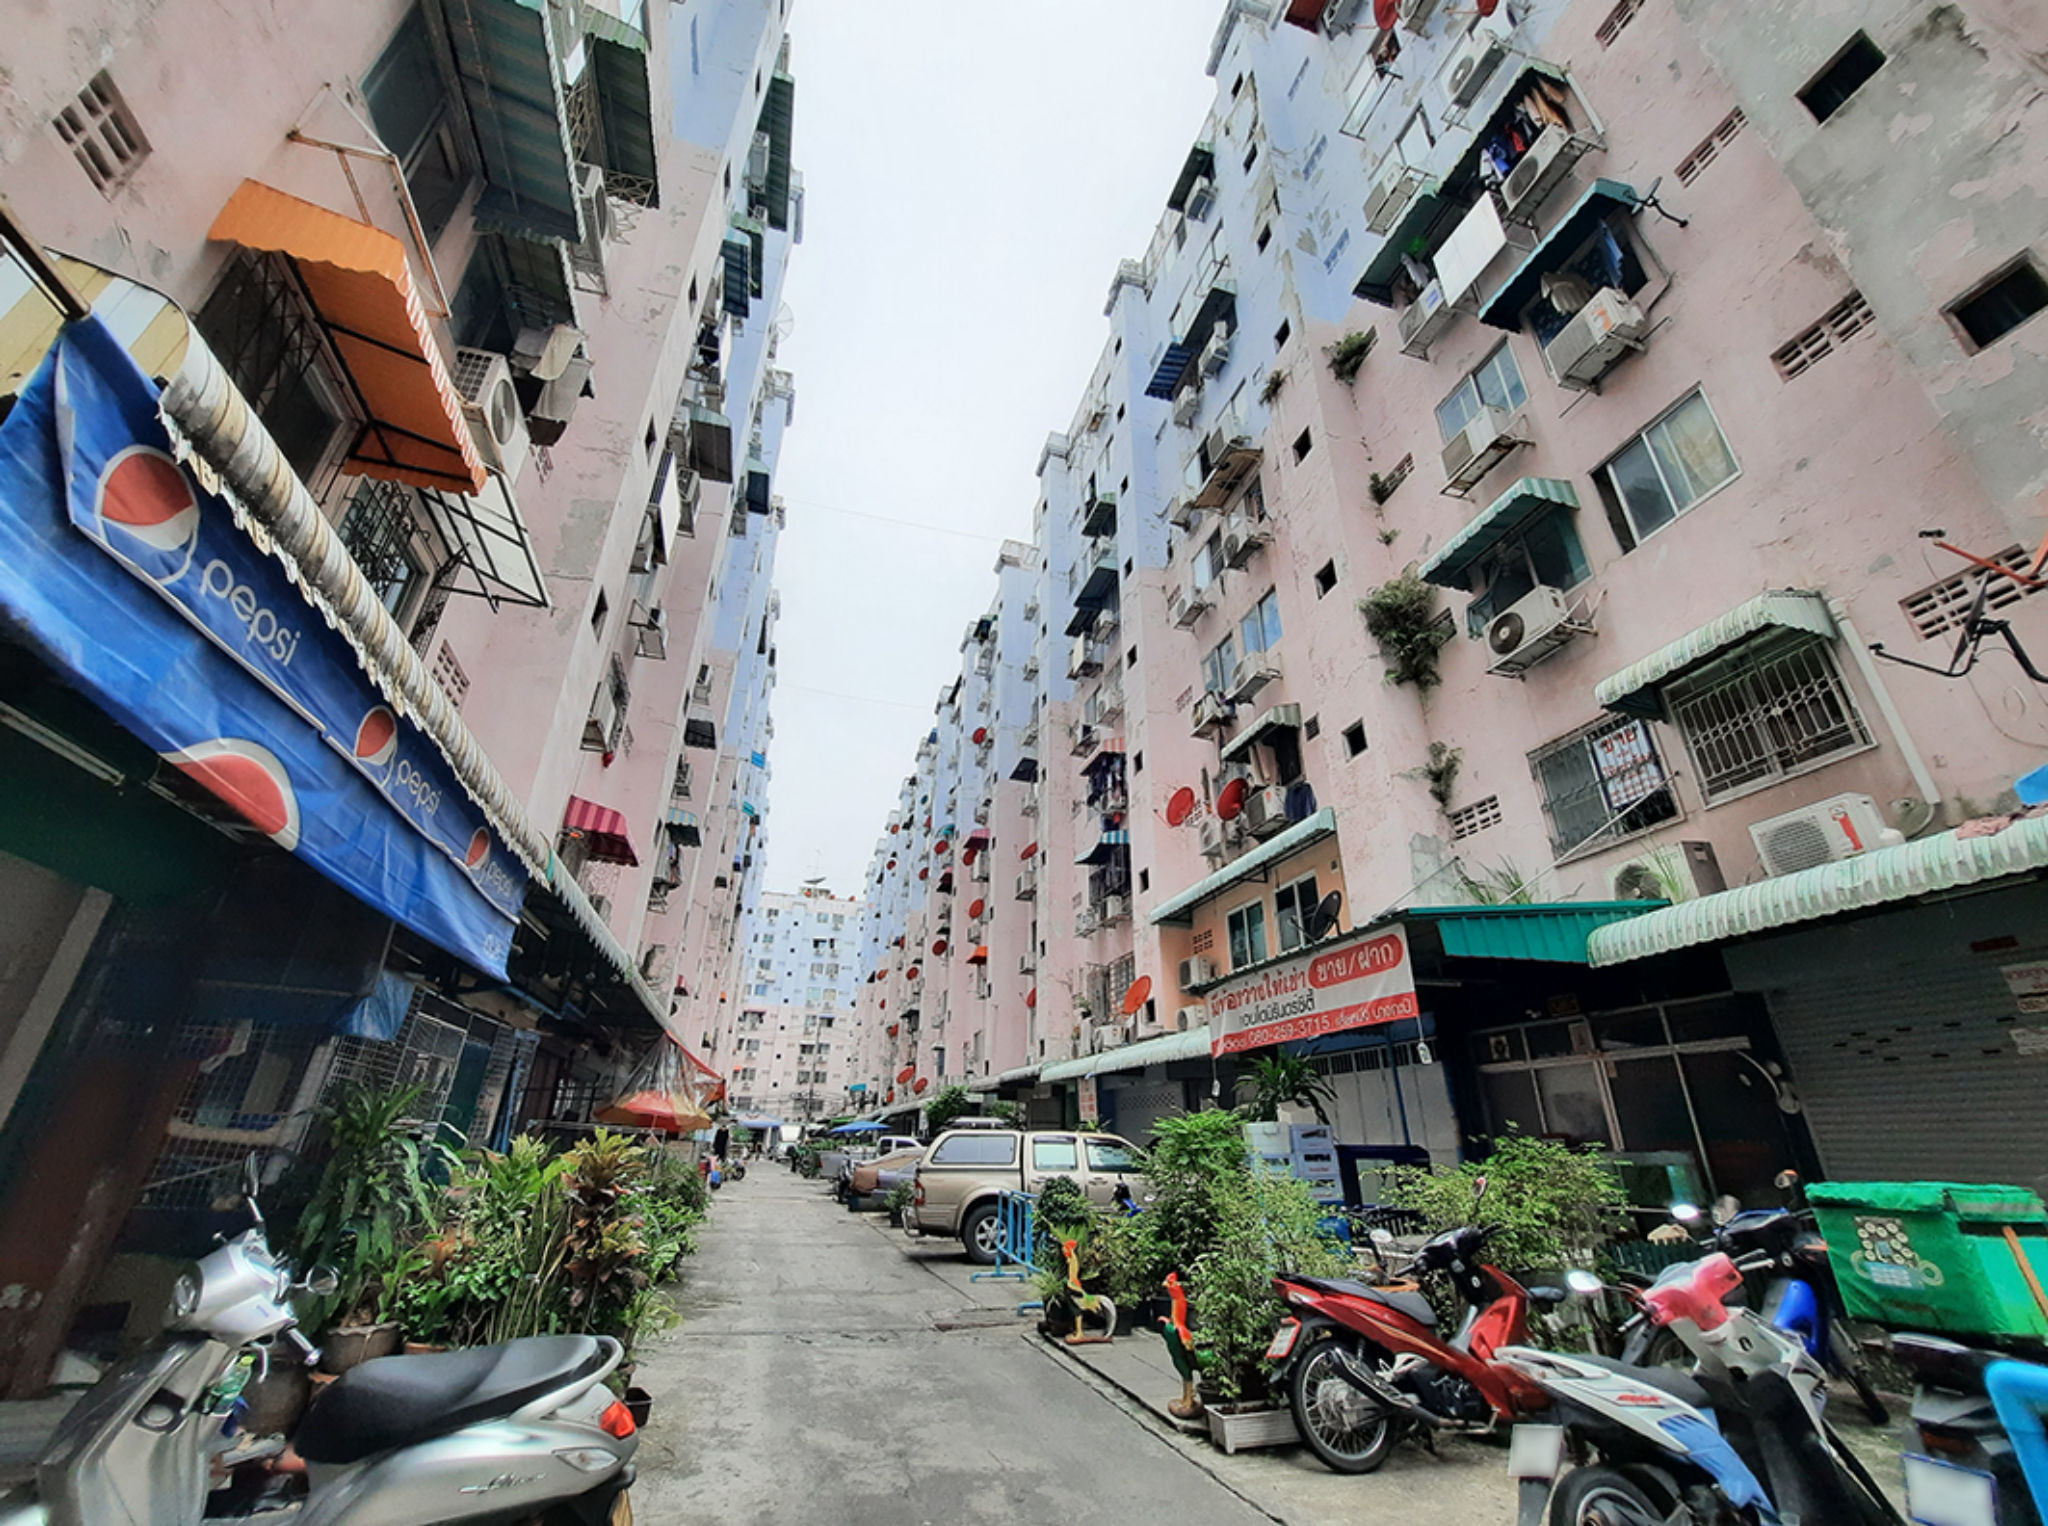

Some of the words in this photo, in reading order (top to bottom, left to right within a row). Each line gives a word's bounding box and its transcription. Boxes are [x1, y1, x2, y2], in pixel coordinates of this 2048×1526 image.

[201, 559, 301, 667] pepsi
[395, 758, 442, 815] pepsi
[485, 860, 516, 897] pepsi
[1316, 942, 1394, 982] ขาย/ฝาก
